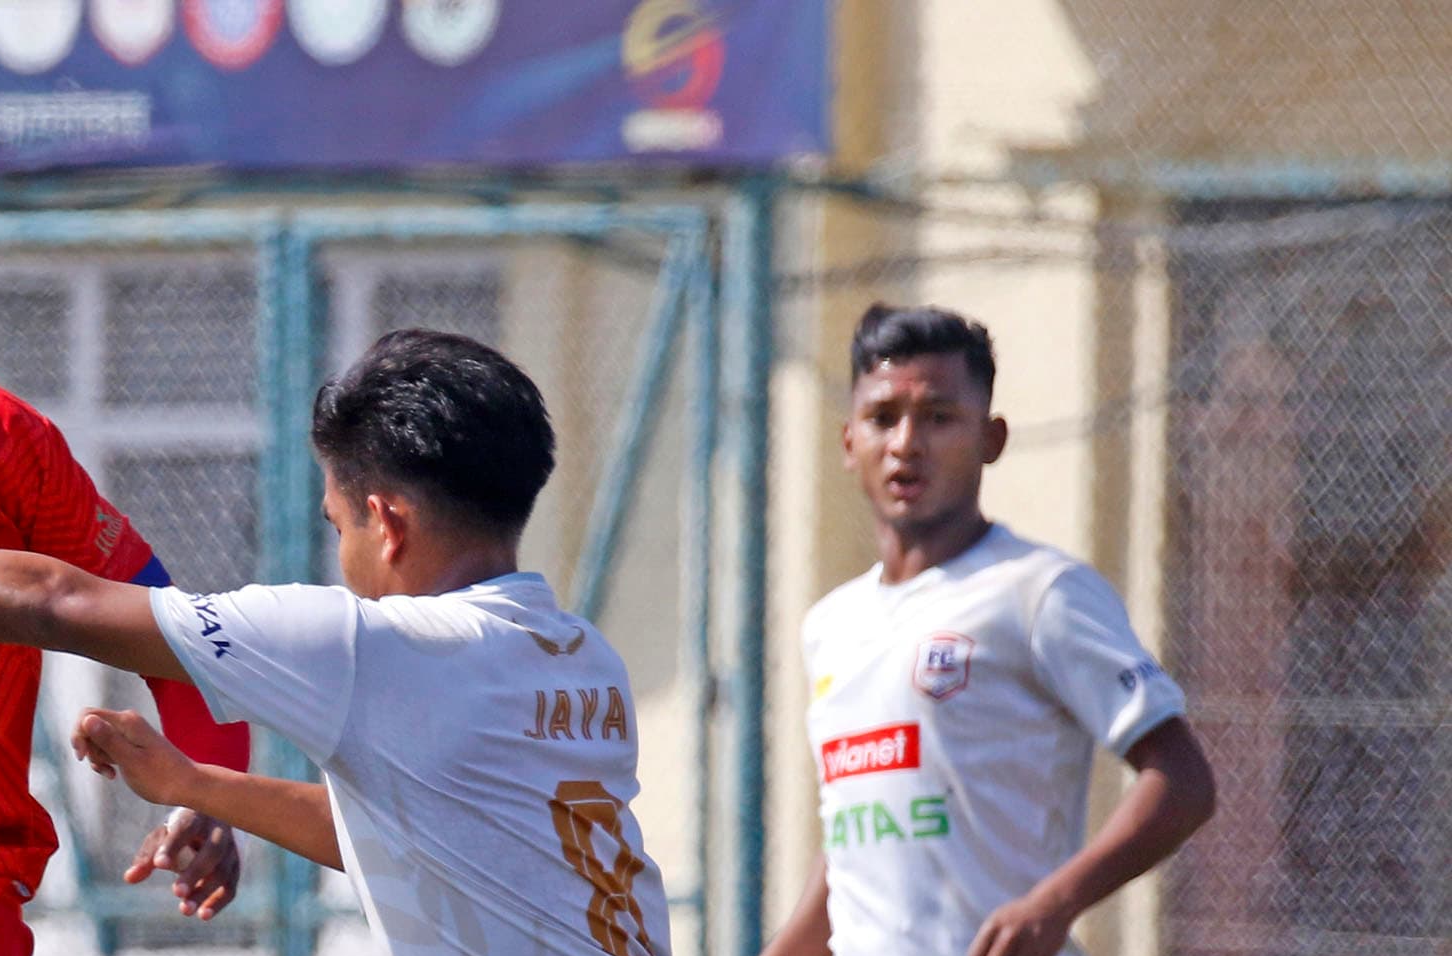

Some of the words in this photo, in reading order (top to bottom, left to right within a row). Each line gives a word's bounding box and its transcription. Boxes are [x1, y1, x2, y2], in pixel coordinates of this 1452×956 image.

[191, 592, 233, 660] YAK
[523, 686, 628, 742] JAYA
[824, 729, 908, 776] vianet
[824, 796, 951, 848] ATAS
